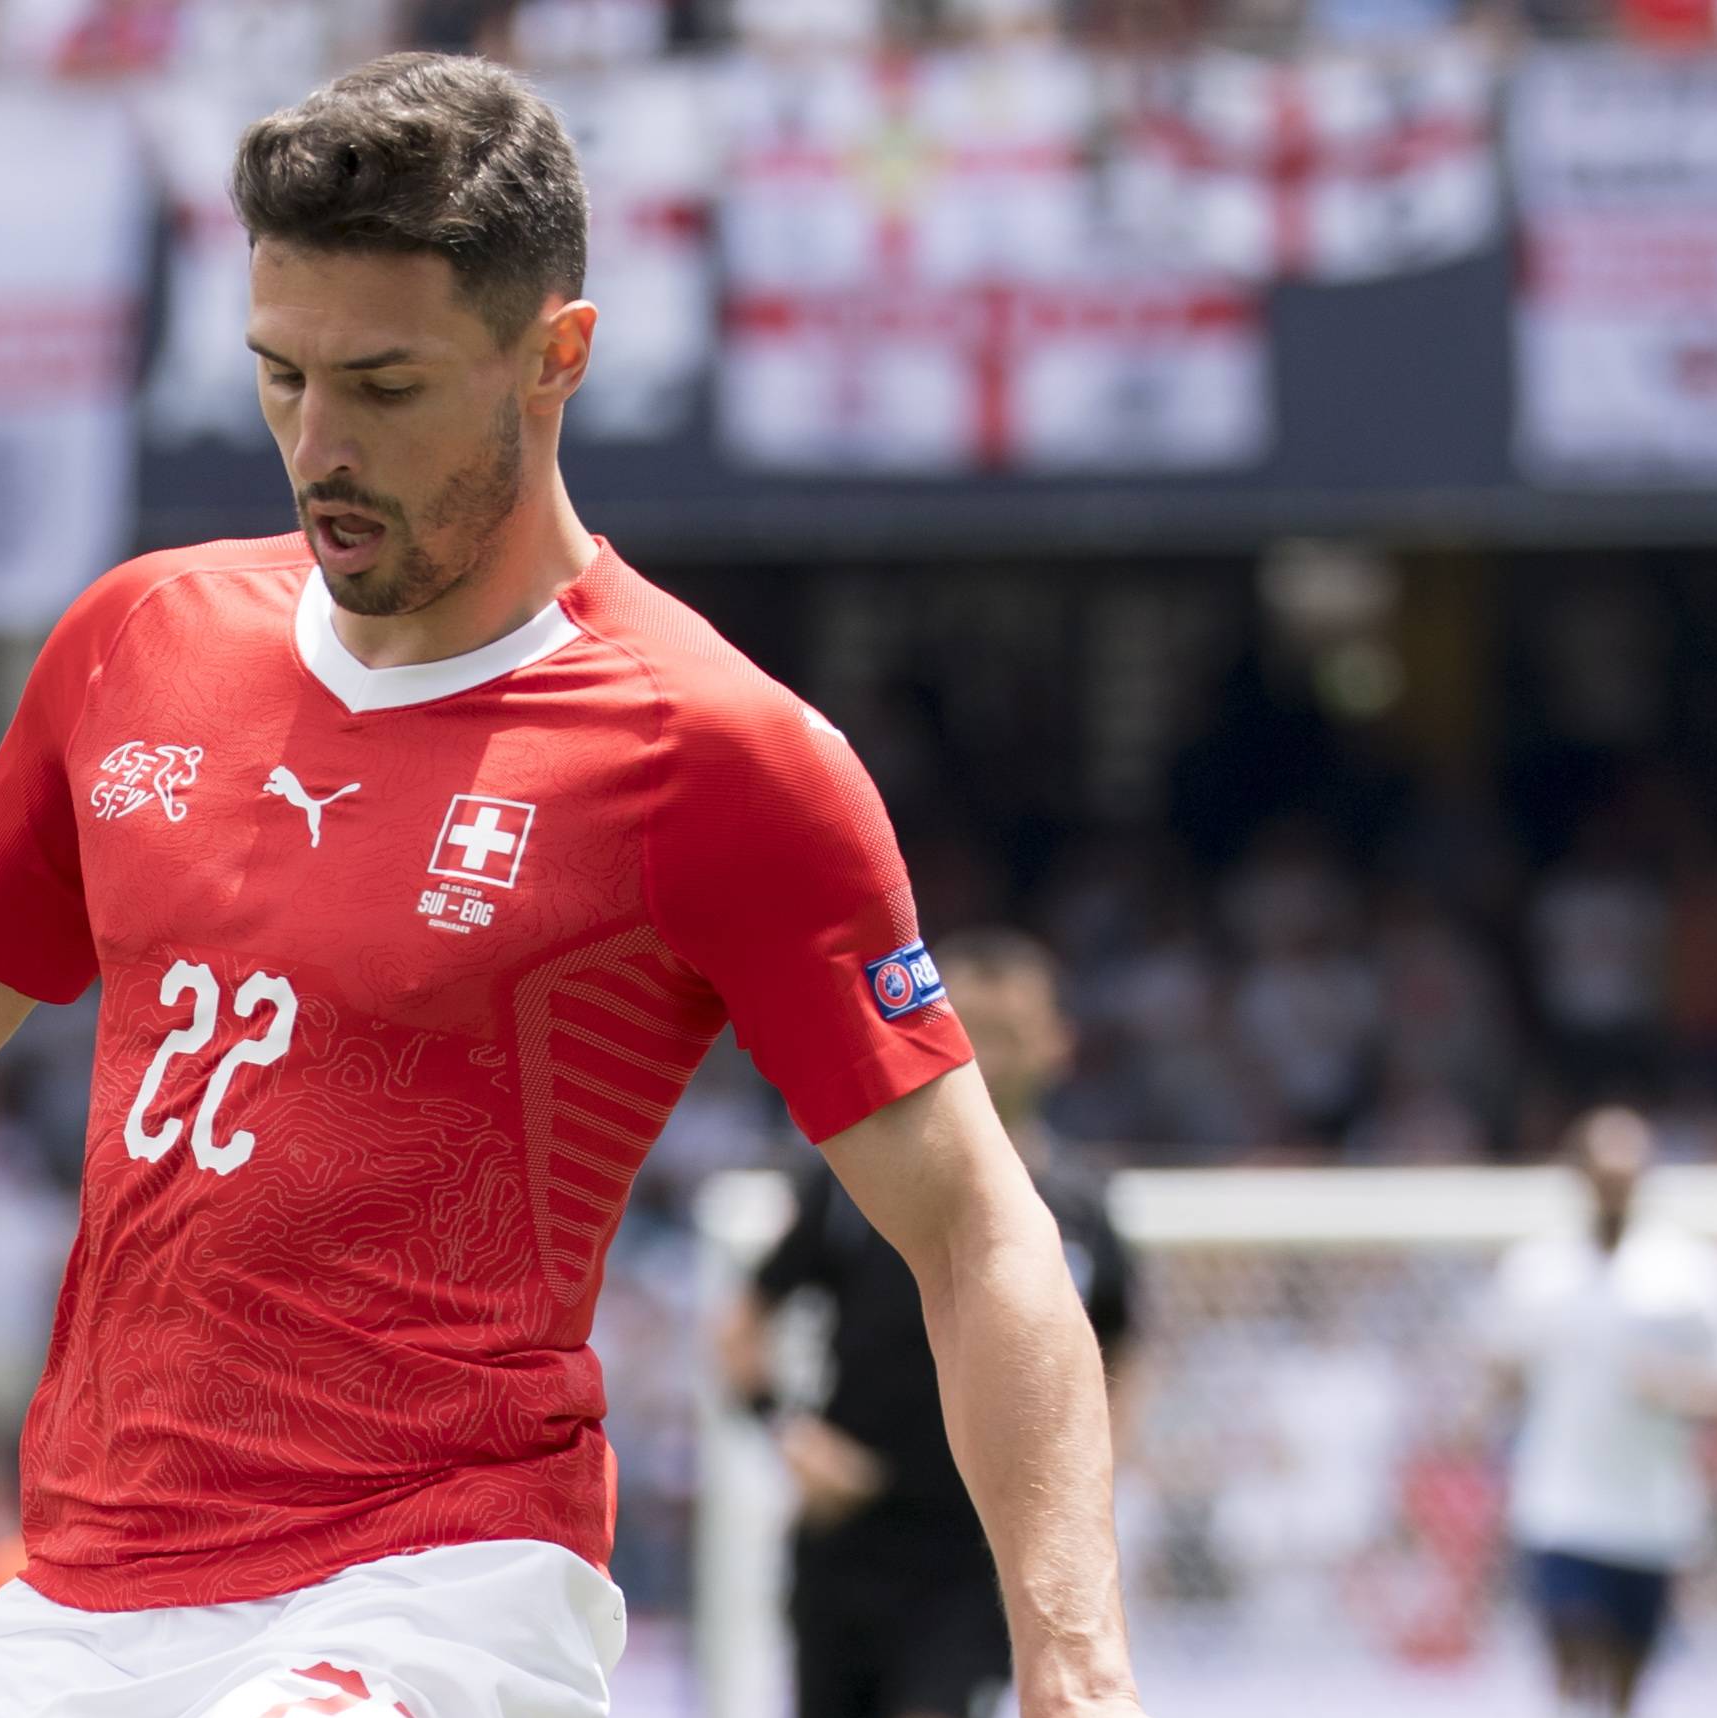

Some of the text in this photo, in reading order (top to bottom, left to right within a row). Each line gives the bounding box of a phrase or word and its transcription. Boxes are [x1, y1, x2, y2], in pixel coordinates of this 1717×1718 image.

[418, 891, 447, 915] SUI
[460, 899, 494, 926] ENG
[123, 957, 298, 1177] 22
